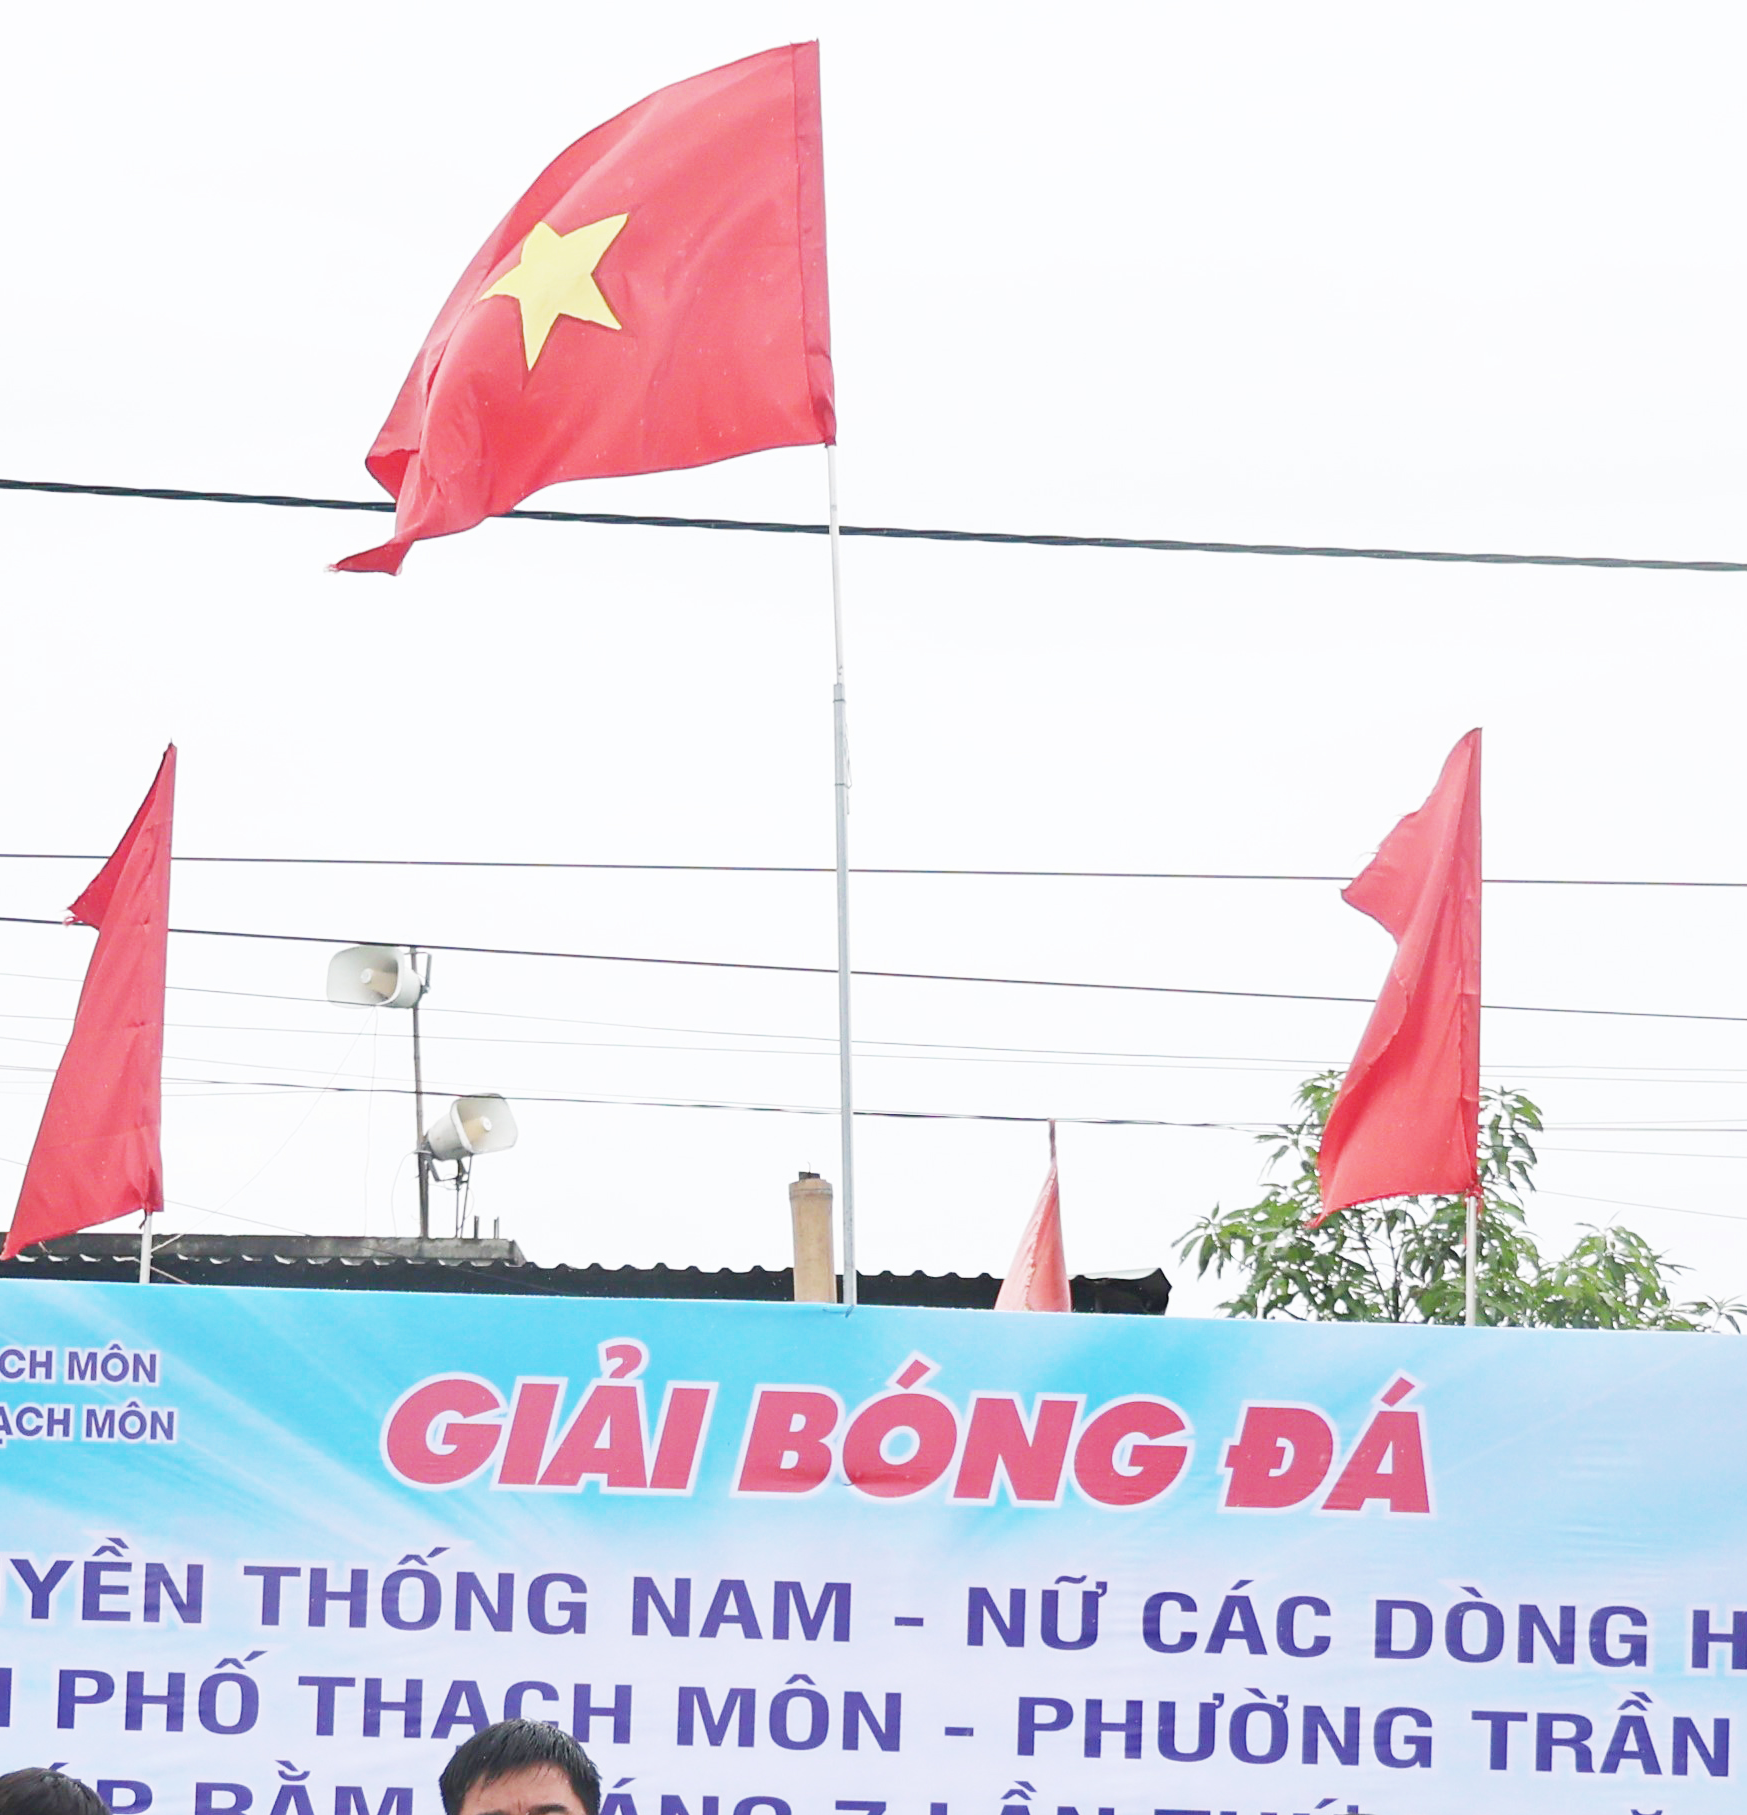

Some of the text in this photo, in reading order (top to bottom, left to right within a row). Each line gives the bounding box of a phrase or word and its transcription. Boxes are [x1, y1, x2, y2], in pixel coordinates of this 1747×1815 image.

[68, 1343, 157, 1383] MÔN
[85, 1401, 174, 1440] MÔN
[389, 1346, 1428, 1512] GIẢI BÓNG ĐÁ
[244, 1548, 586, 1634] THỐNG
[632, 1577, 851, 1641] NAM
[968, 1576, 1107, 1650] NỮ
[1143, 1580, 1330, 1657] CÁC
[1375, 1587, 1647, 1667] DÒNG
[57, 1651, 264, 1734] PHỐ
[677, 1675, 901, 1751] MÔN
[1018, 1688, 1432, 1768] PHƯỜNG
[1472, 1692, 1729, 1776] TRẦN
